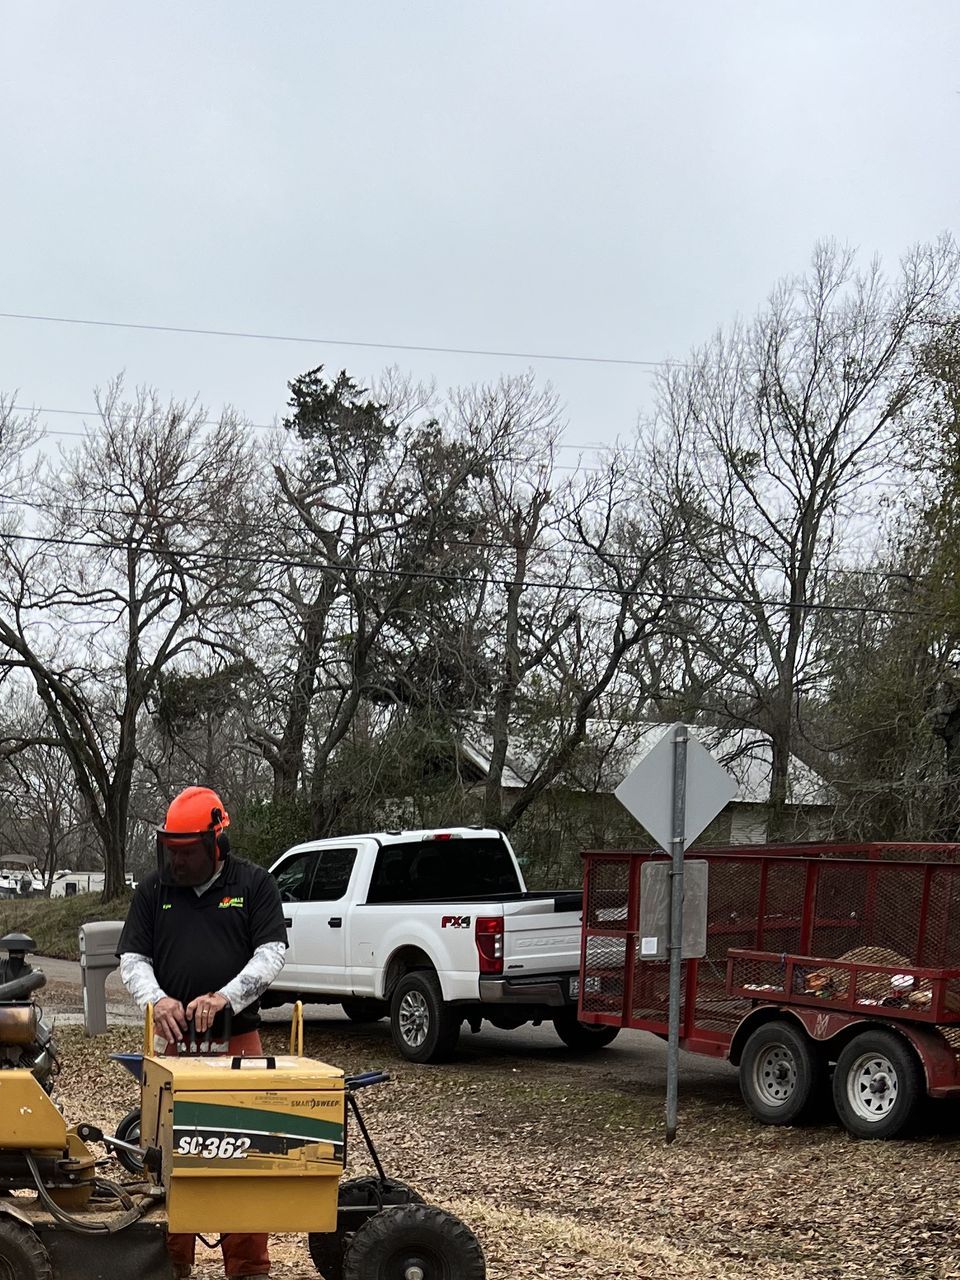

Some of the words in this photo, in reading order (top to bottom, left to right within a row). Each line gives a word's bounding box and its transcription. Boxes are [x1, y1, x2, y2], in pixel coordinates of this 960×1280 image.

[441, 915, 471, 928] FX4
[518, 935, 580, 947] SUPE
[177, 1136, 251, 1159] SC362
